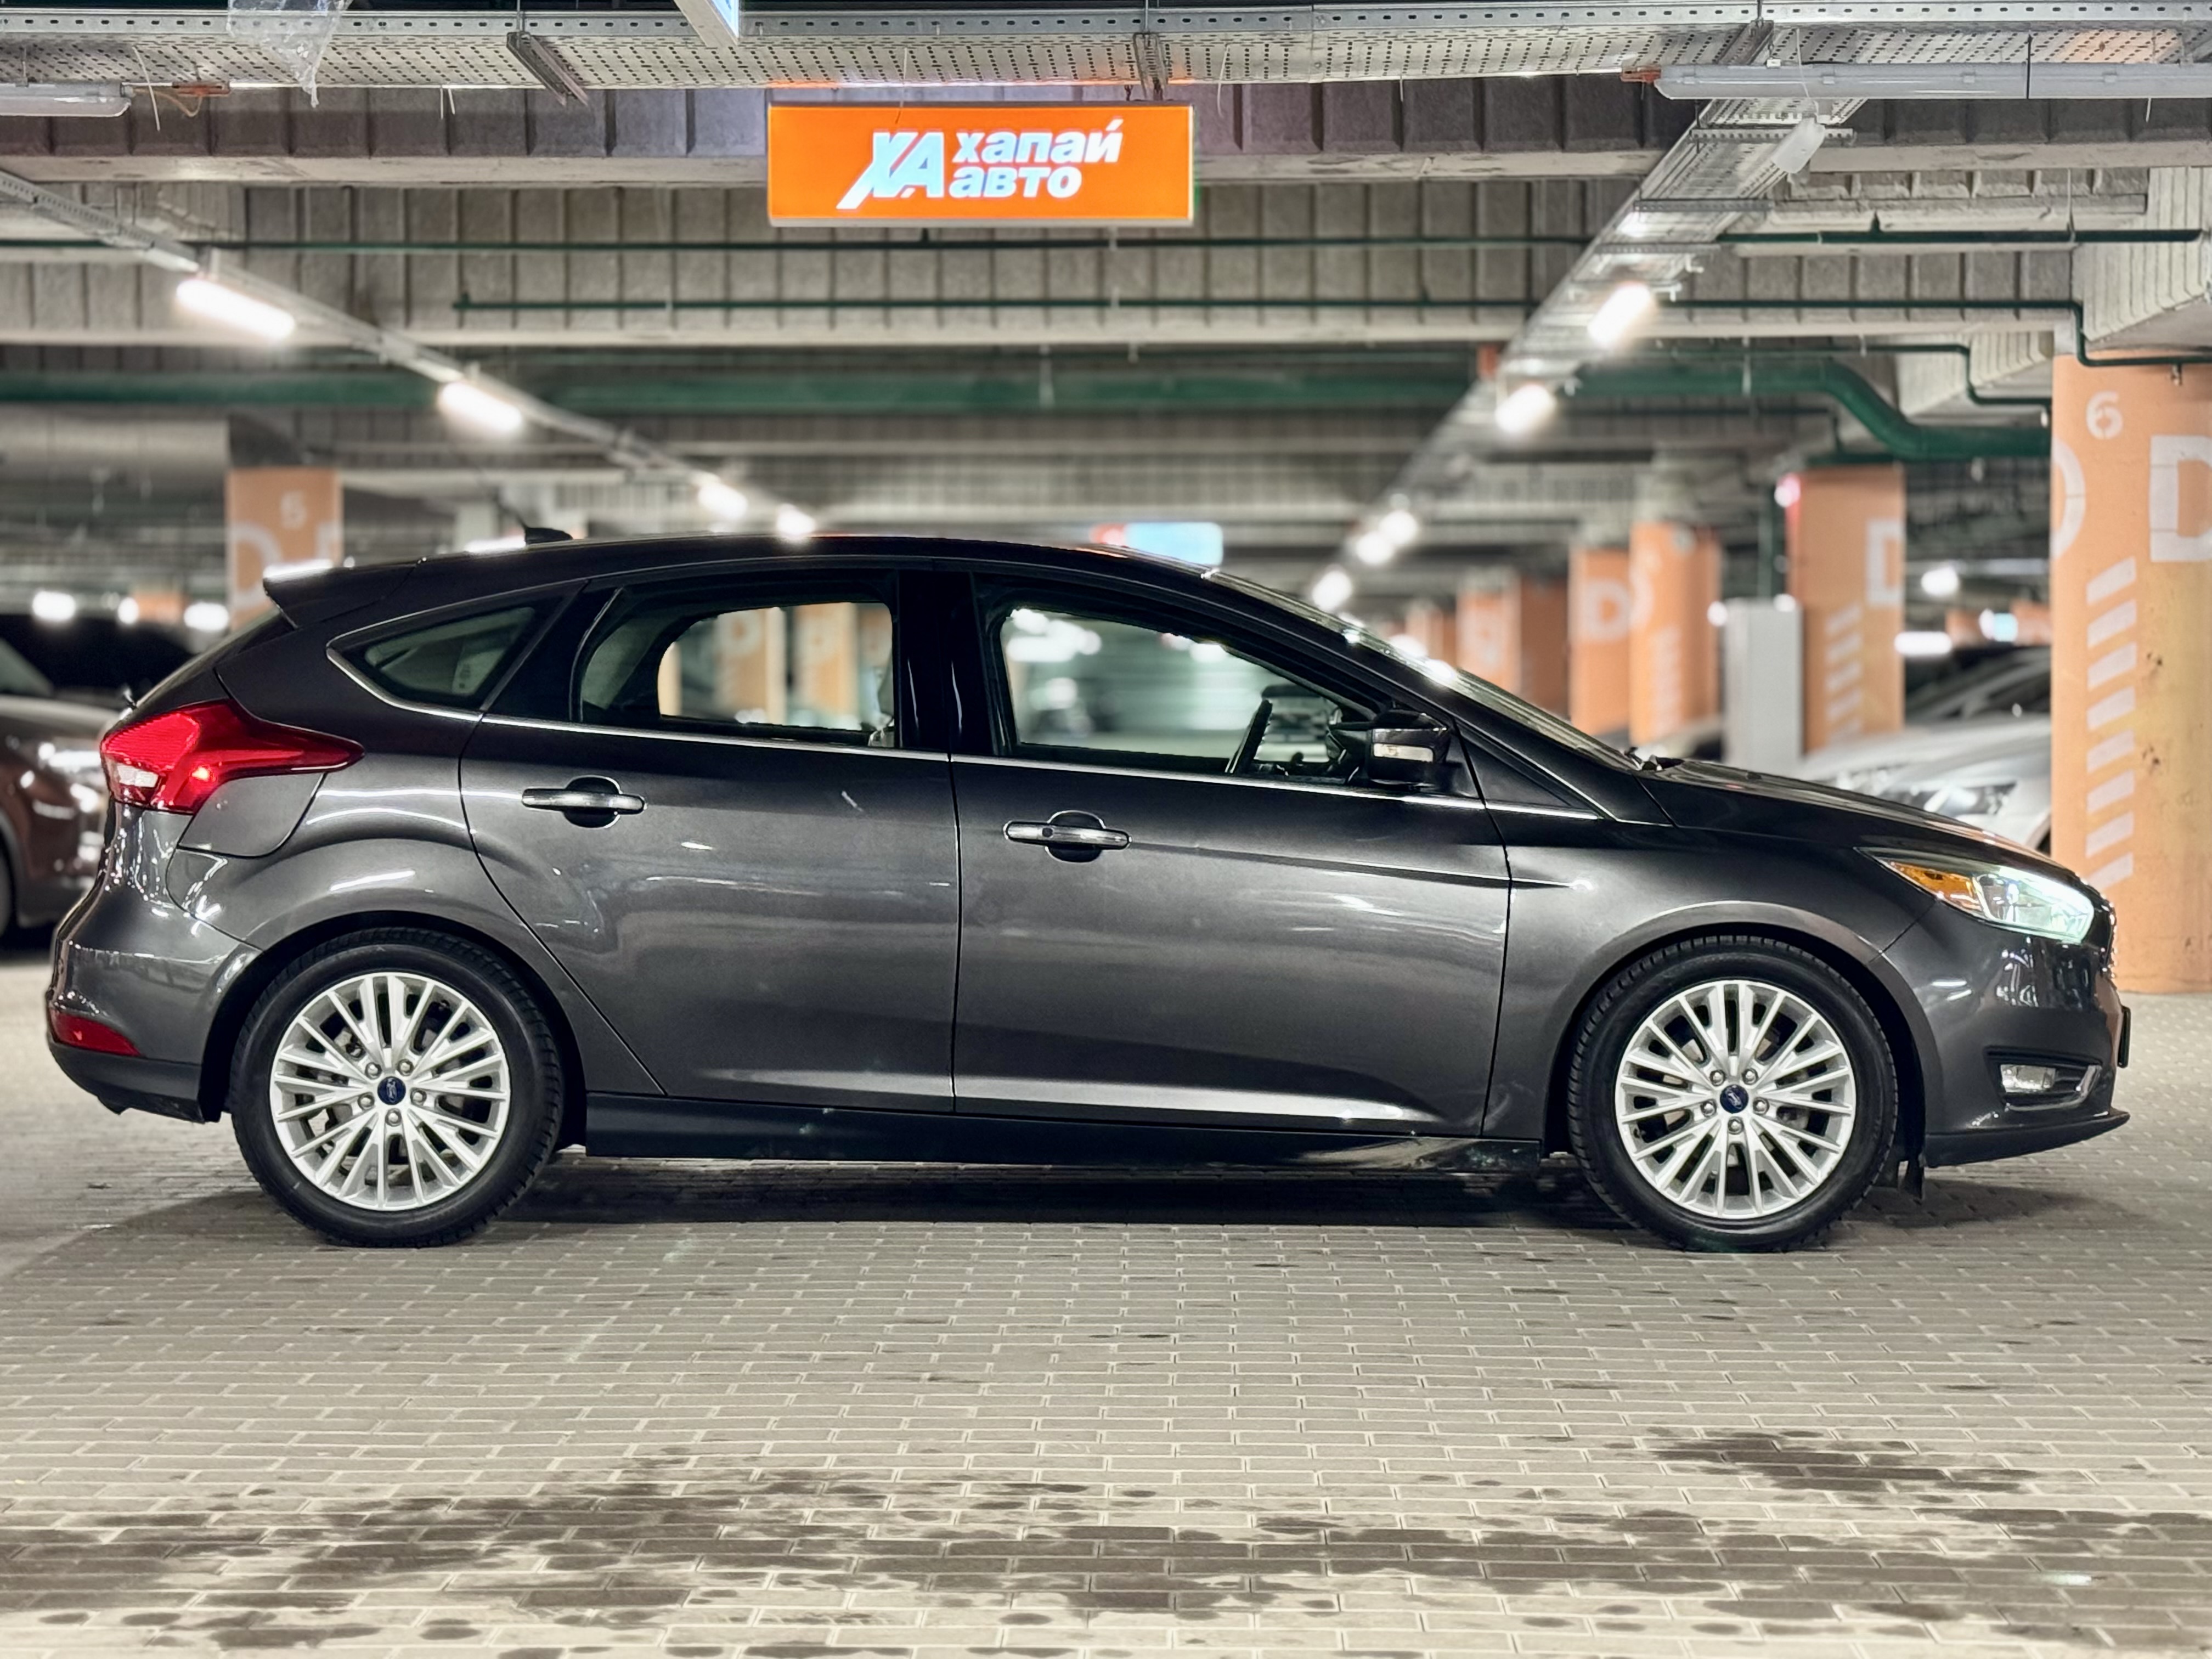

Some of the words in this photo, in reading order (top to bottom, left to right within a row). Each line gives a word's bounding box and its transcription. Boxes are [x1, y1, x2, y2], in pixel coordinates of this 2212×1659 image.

[952, 119, 1124, 163] хапай
[836, 131, 944, 209] ХА
[949, 166, 1082, 198] авто
[2086, 390, 2123, 439] 6
